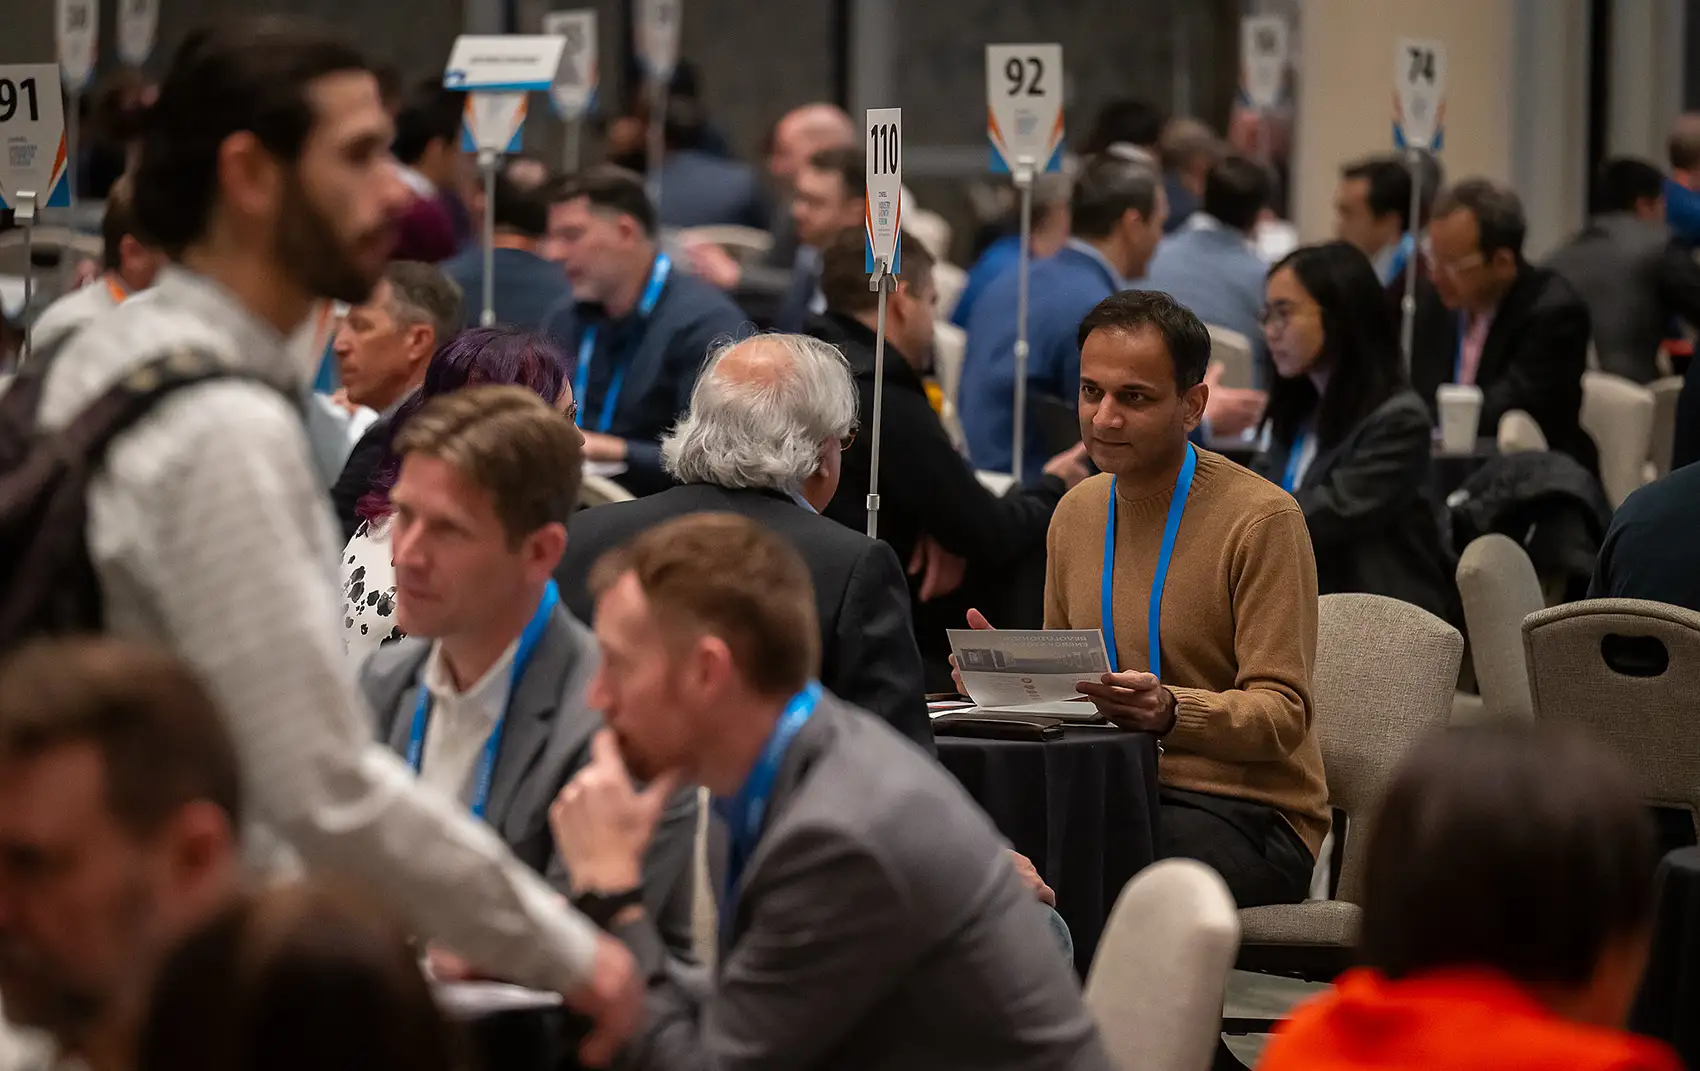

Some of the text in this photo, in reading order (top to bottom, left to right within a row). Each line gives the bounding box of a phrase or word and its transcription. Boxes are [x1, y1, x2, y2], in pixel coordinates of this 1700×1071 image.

[1006, 56, 1046, 97] 92
[1406, 46, 1435, 86] 74
[0, 78, 38, 122] 91
[871, 123, 898, 175] 110
